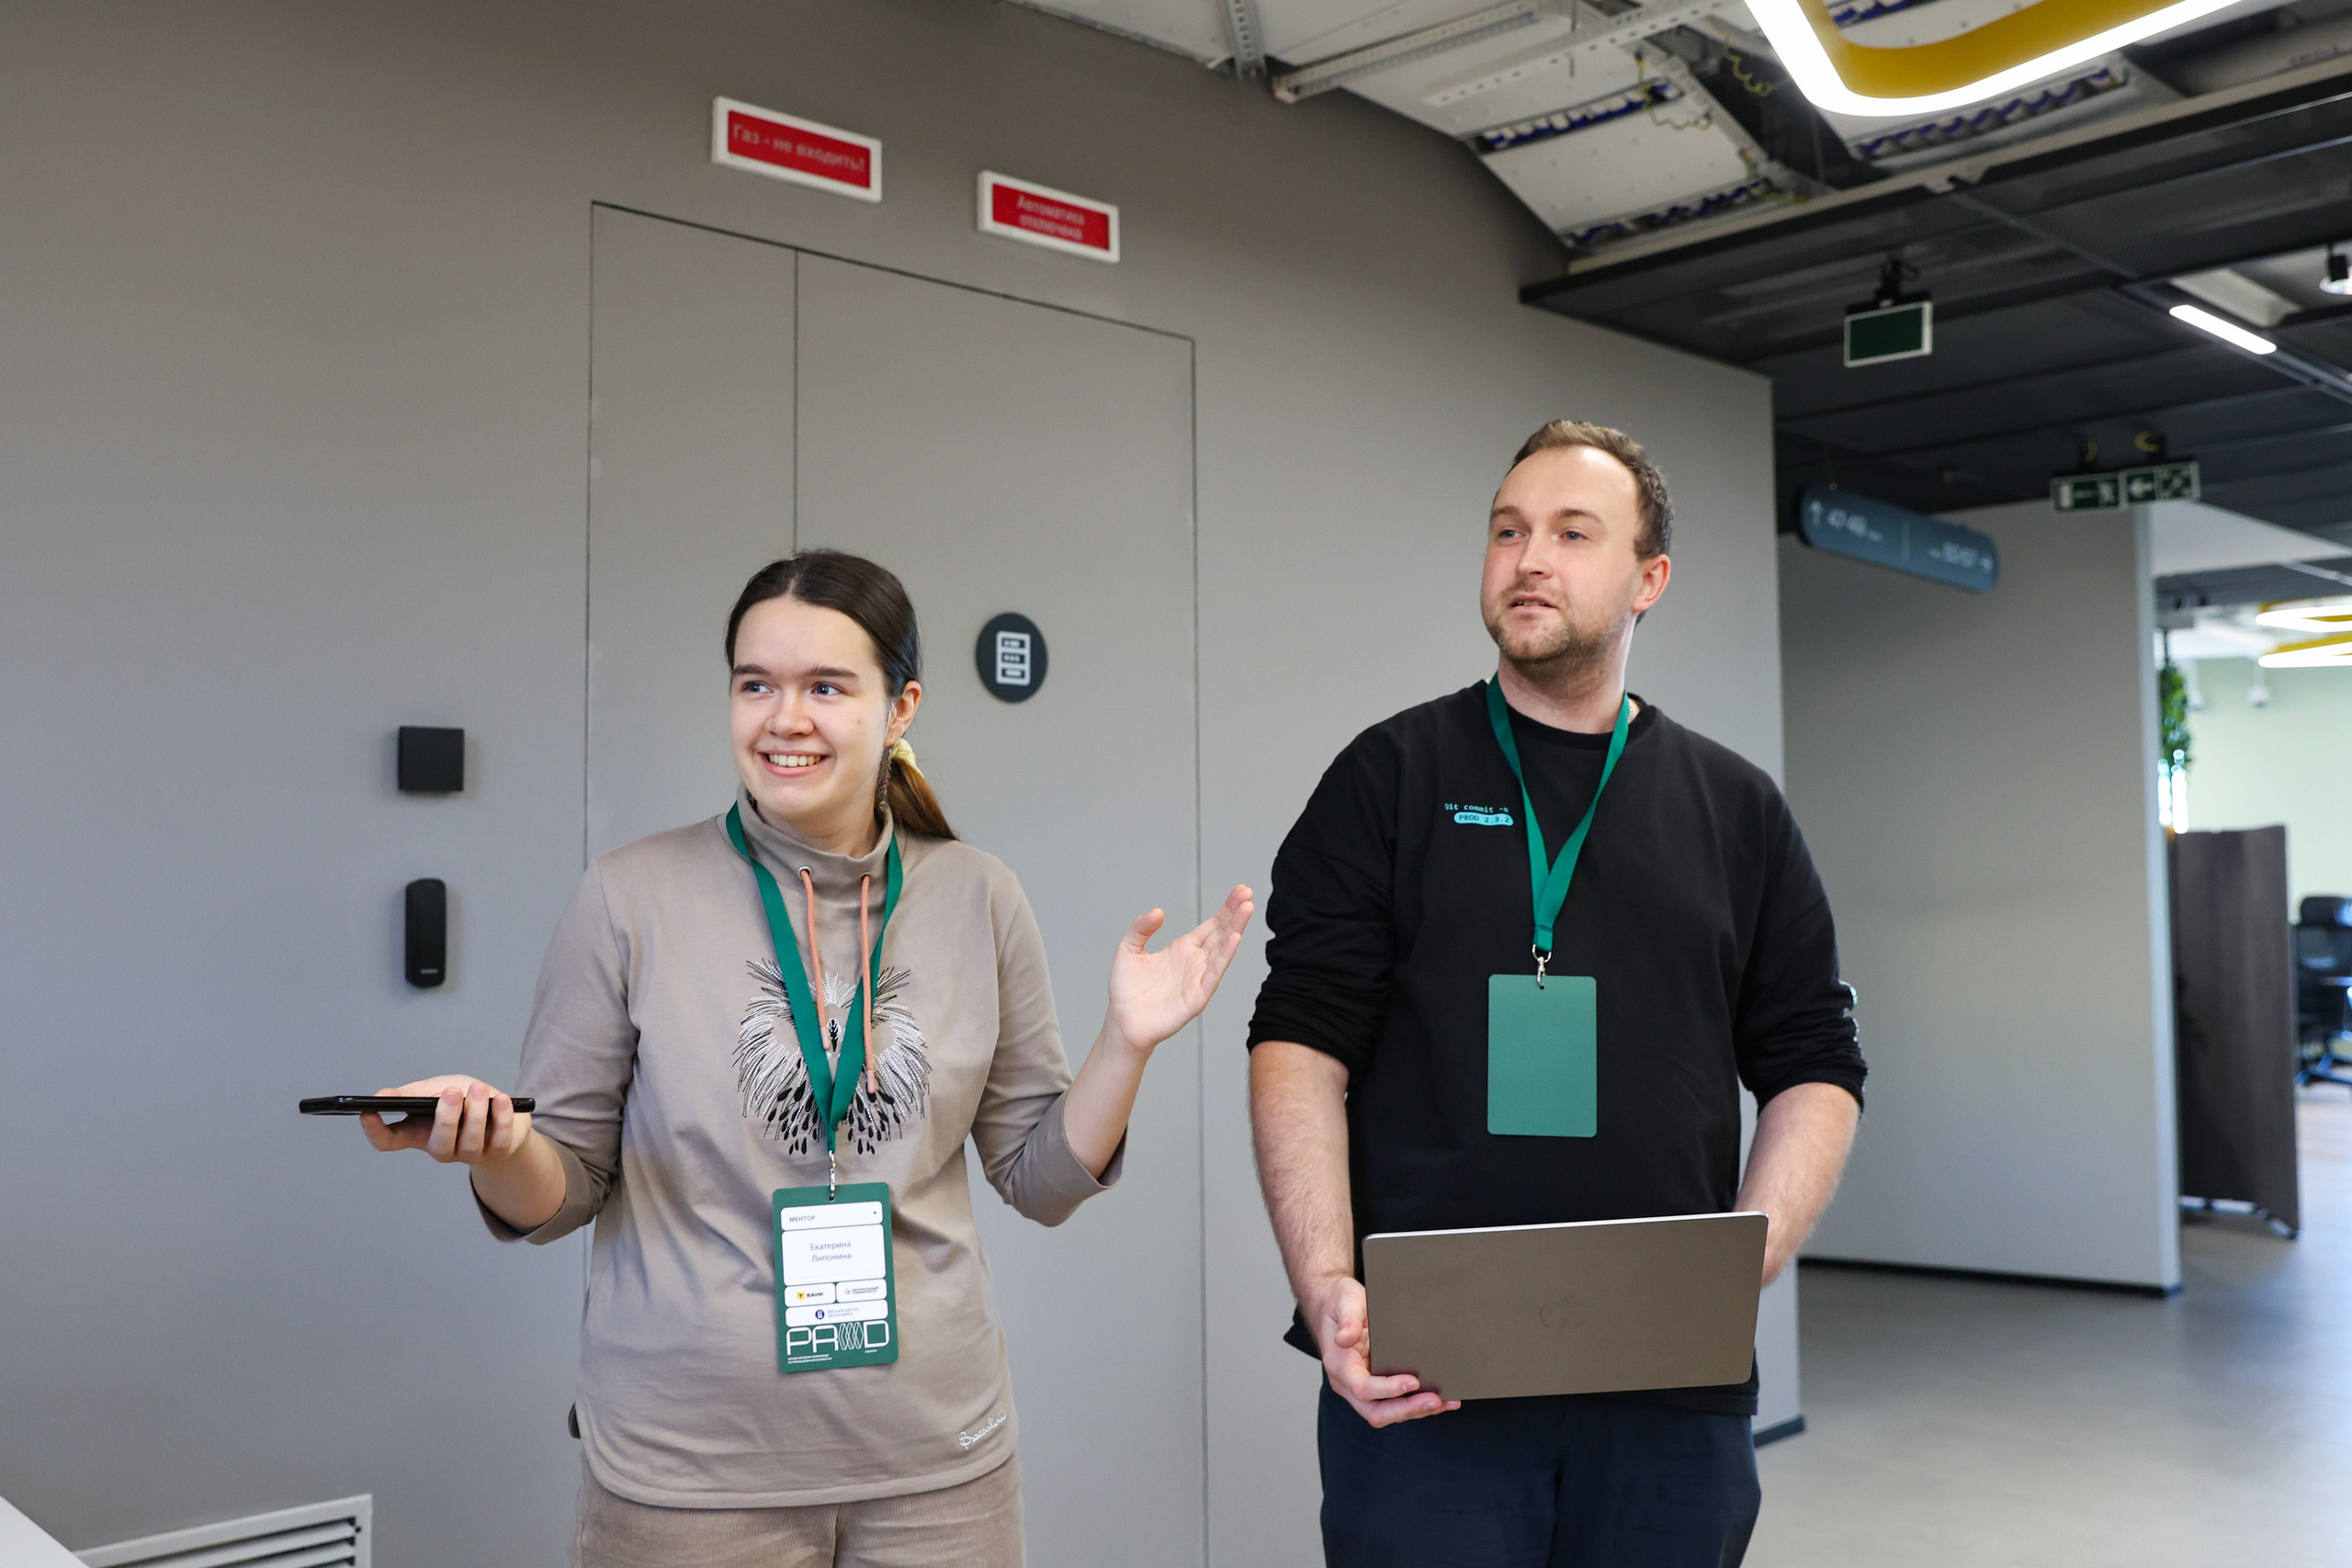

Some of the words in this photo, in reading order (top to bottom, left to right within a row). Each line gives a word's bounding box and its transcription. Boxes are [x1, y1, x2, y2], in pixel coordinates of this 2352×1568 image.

[733, 124, 760, 144] Газ
[774, 140, 792, 152] не
[797, 144, 865, 172] входить!
[1464, 804, 1494, 813] commit
[810, 1241, 852, 1251] Екатерина
[811, 1253, 852, 1262] Липонина
